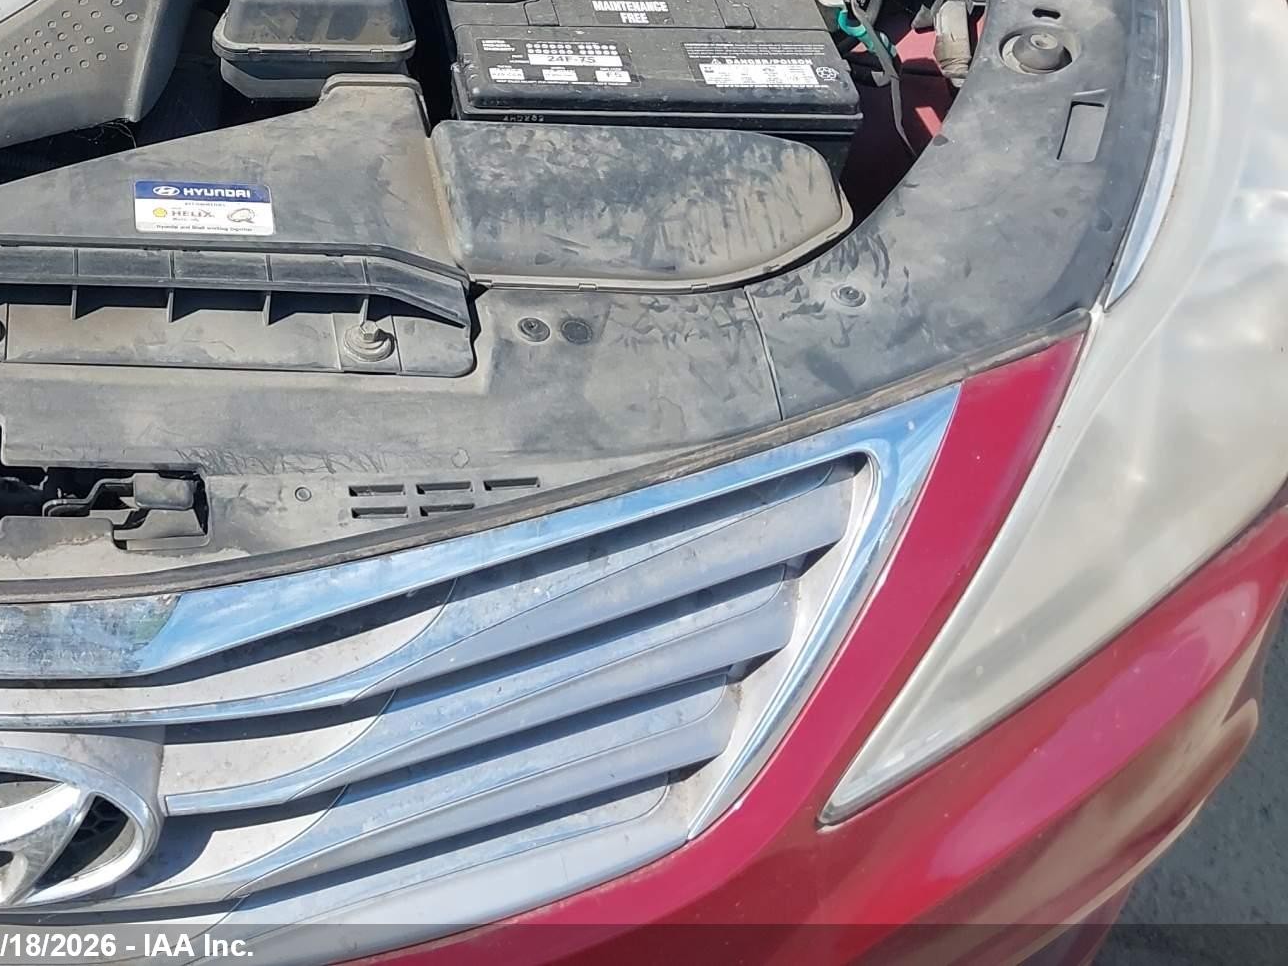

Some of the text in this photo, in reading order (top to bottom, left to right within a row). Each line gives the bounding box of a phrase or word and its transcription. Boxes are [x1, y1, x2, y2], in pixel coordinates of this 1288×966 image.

[592, 0, 669, 12] MAINTENANCE
[619, 12, 650, 24] FREE
[183, 187, 251, 198] HYUNDAI
